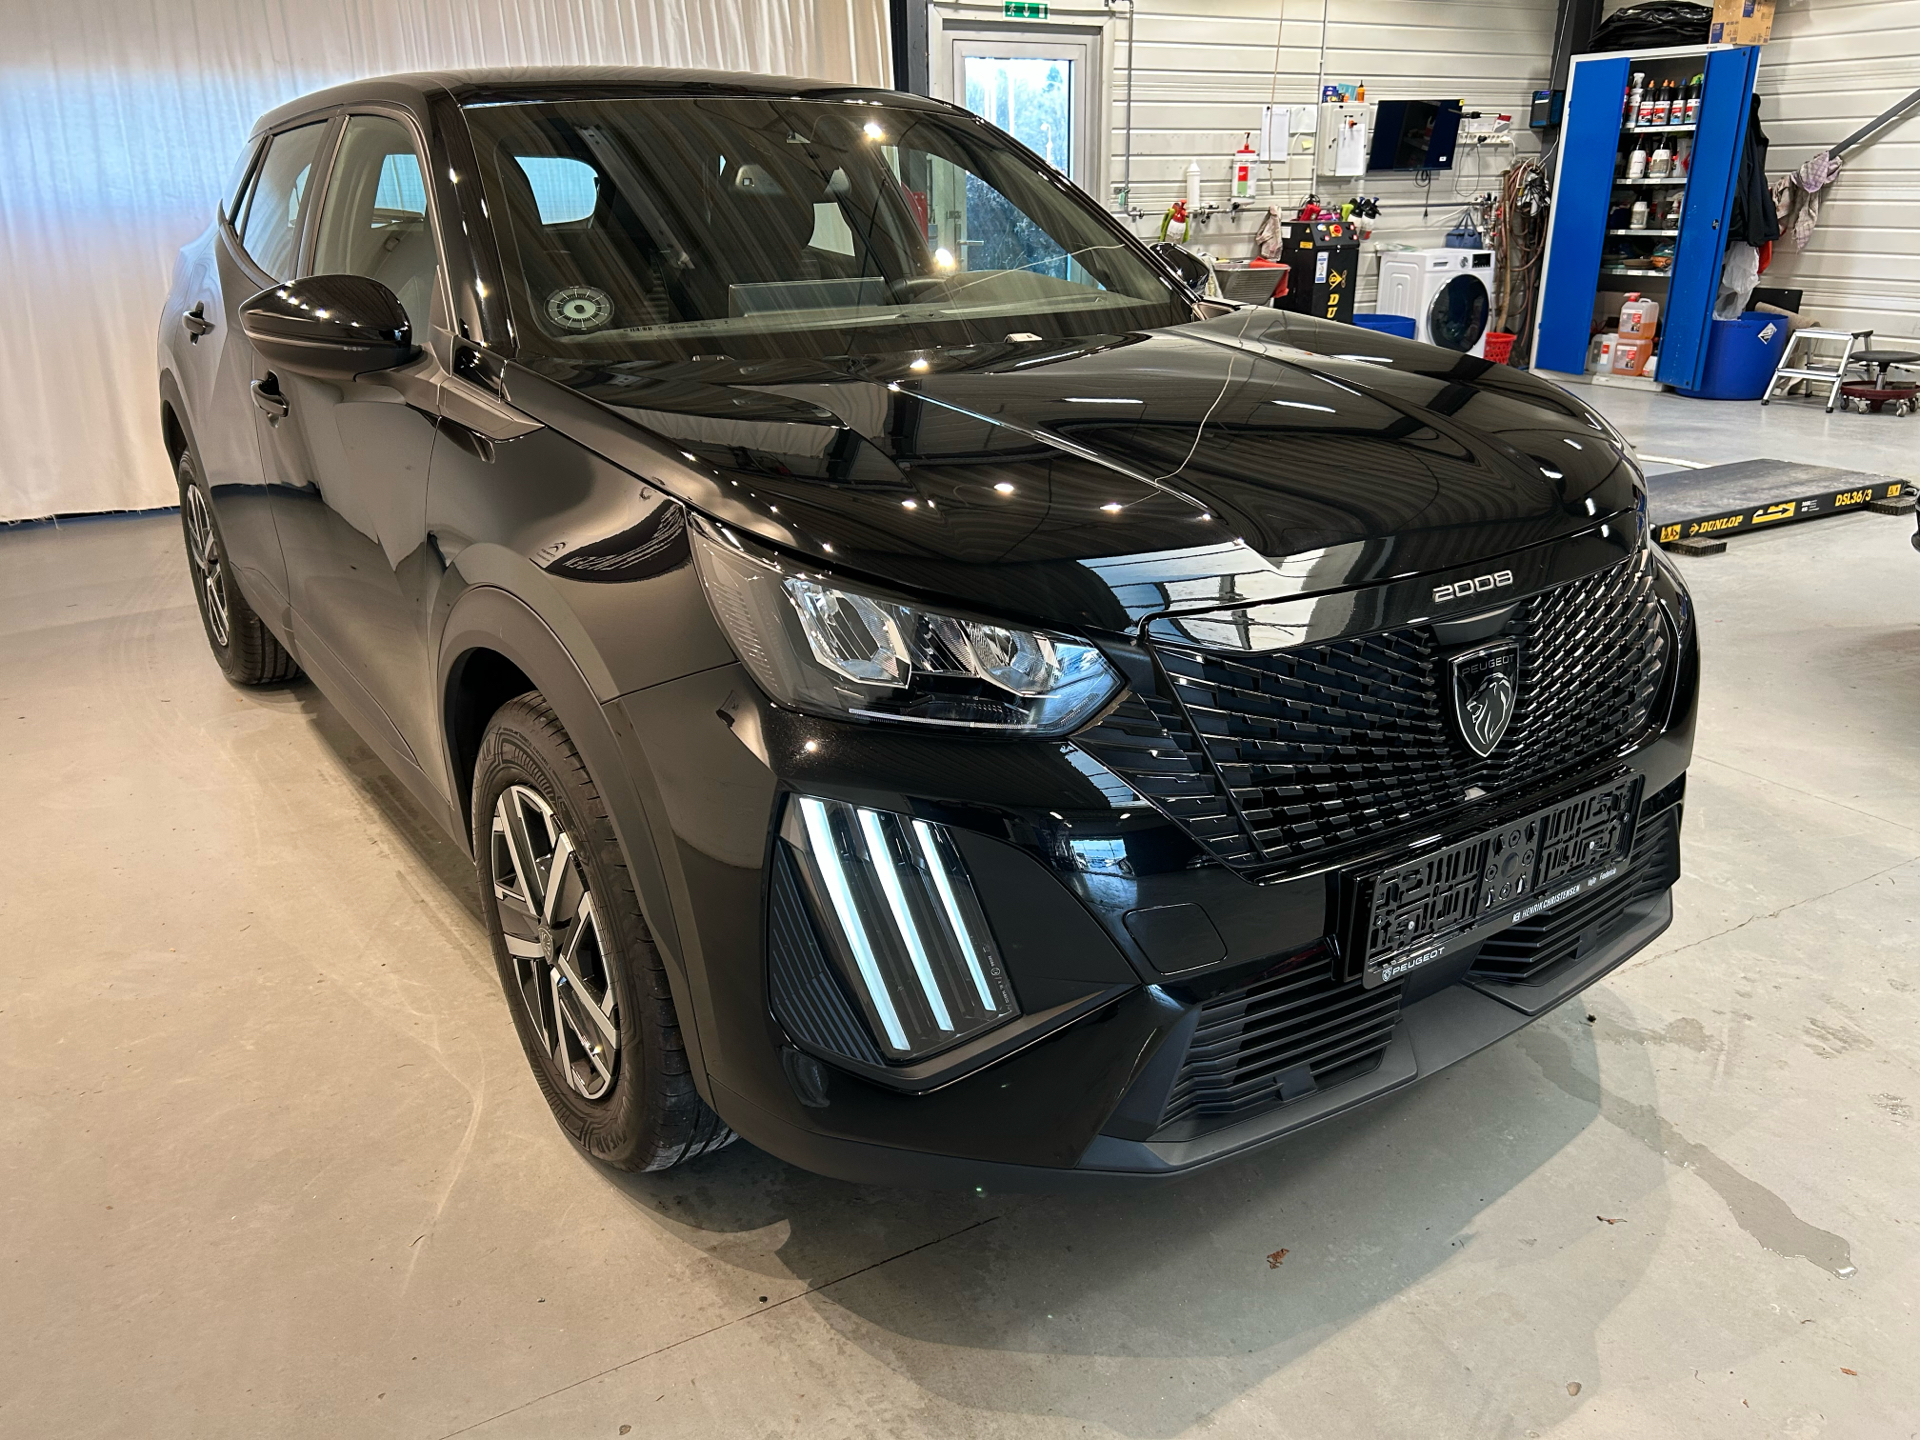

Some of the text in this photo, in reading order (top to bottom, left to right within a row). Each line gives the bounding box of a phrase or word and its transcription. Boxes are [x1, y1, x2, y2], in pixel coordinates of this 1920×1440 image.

[1834, 488, 1873, 507] DSL36/3
[1698, 514, 1744, 533] DUNLOP
[1433, 569, 1513, 603] 2008
[1461, 654, 1515, 676] PEUGEOT
[1392, 946, 1446, 975] PEUGEOT
